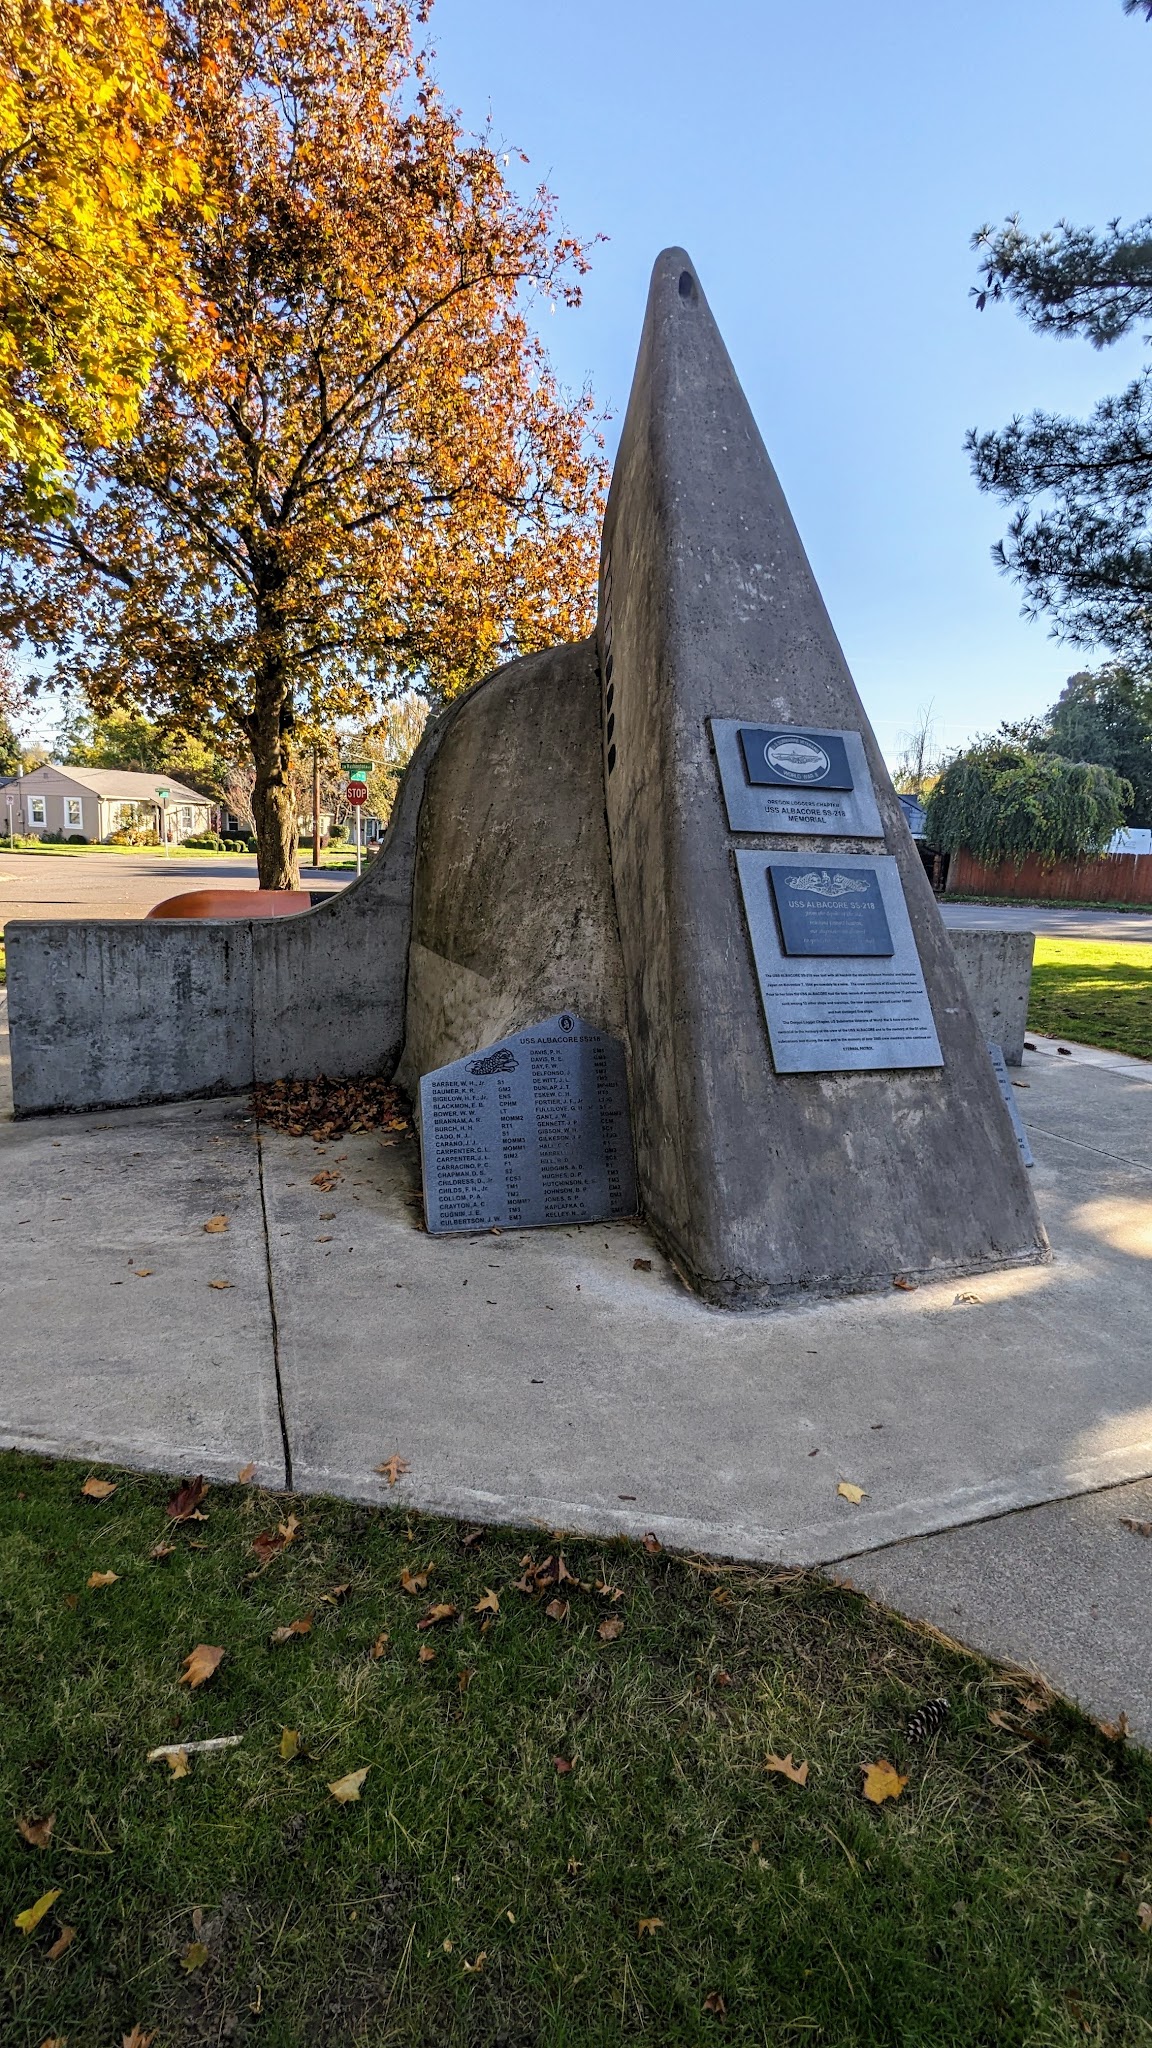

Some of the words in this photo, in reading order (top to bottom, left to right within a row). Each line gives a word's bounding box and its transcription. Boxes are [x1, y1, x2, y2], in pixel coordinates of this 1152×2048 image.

[348, 788, 366, 798] STOP
[764, 806, 780, 814] USS
[781, 808, 821, 816] ALBACORE
[822, 809, 846, 817] SS-218
[788, 815, 827, 824] MEMORIAL
[806, 901, 848, 909] ALBACORE
[850, 902, 875, 910] SS-218
